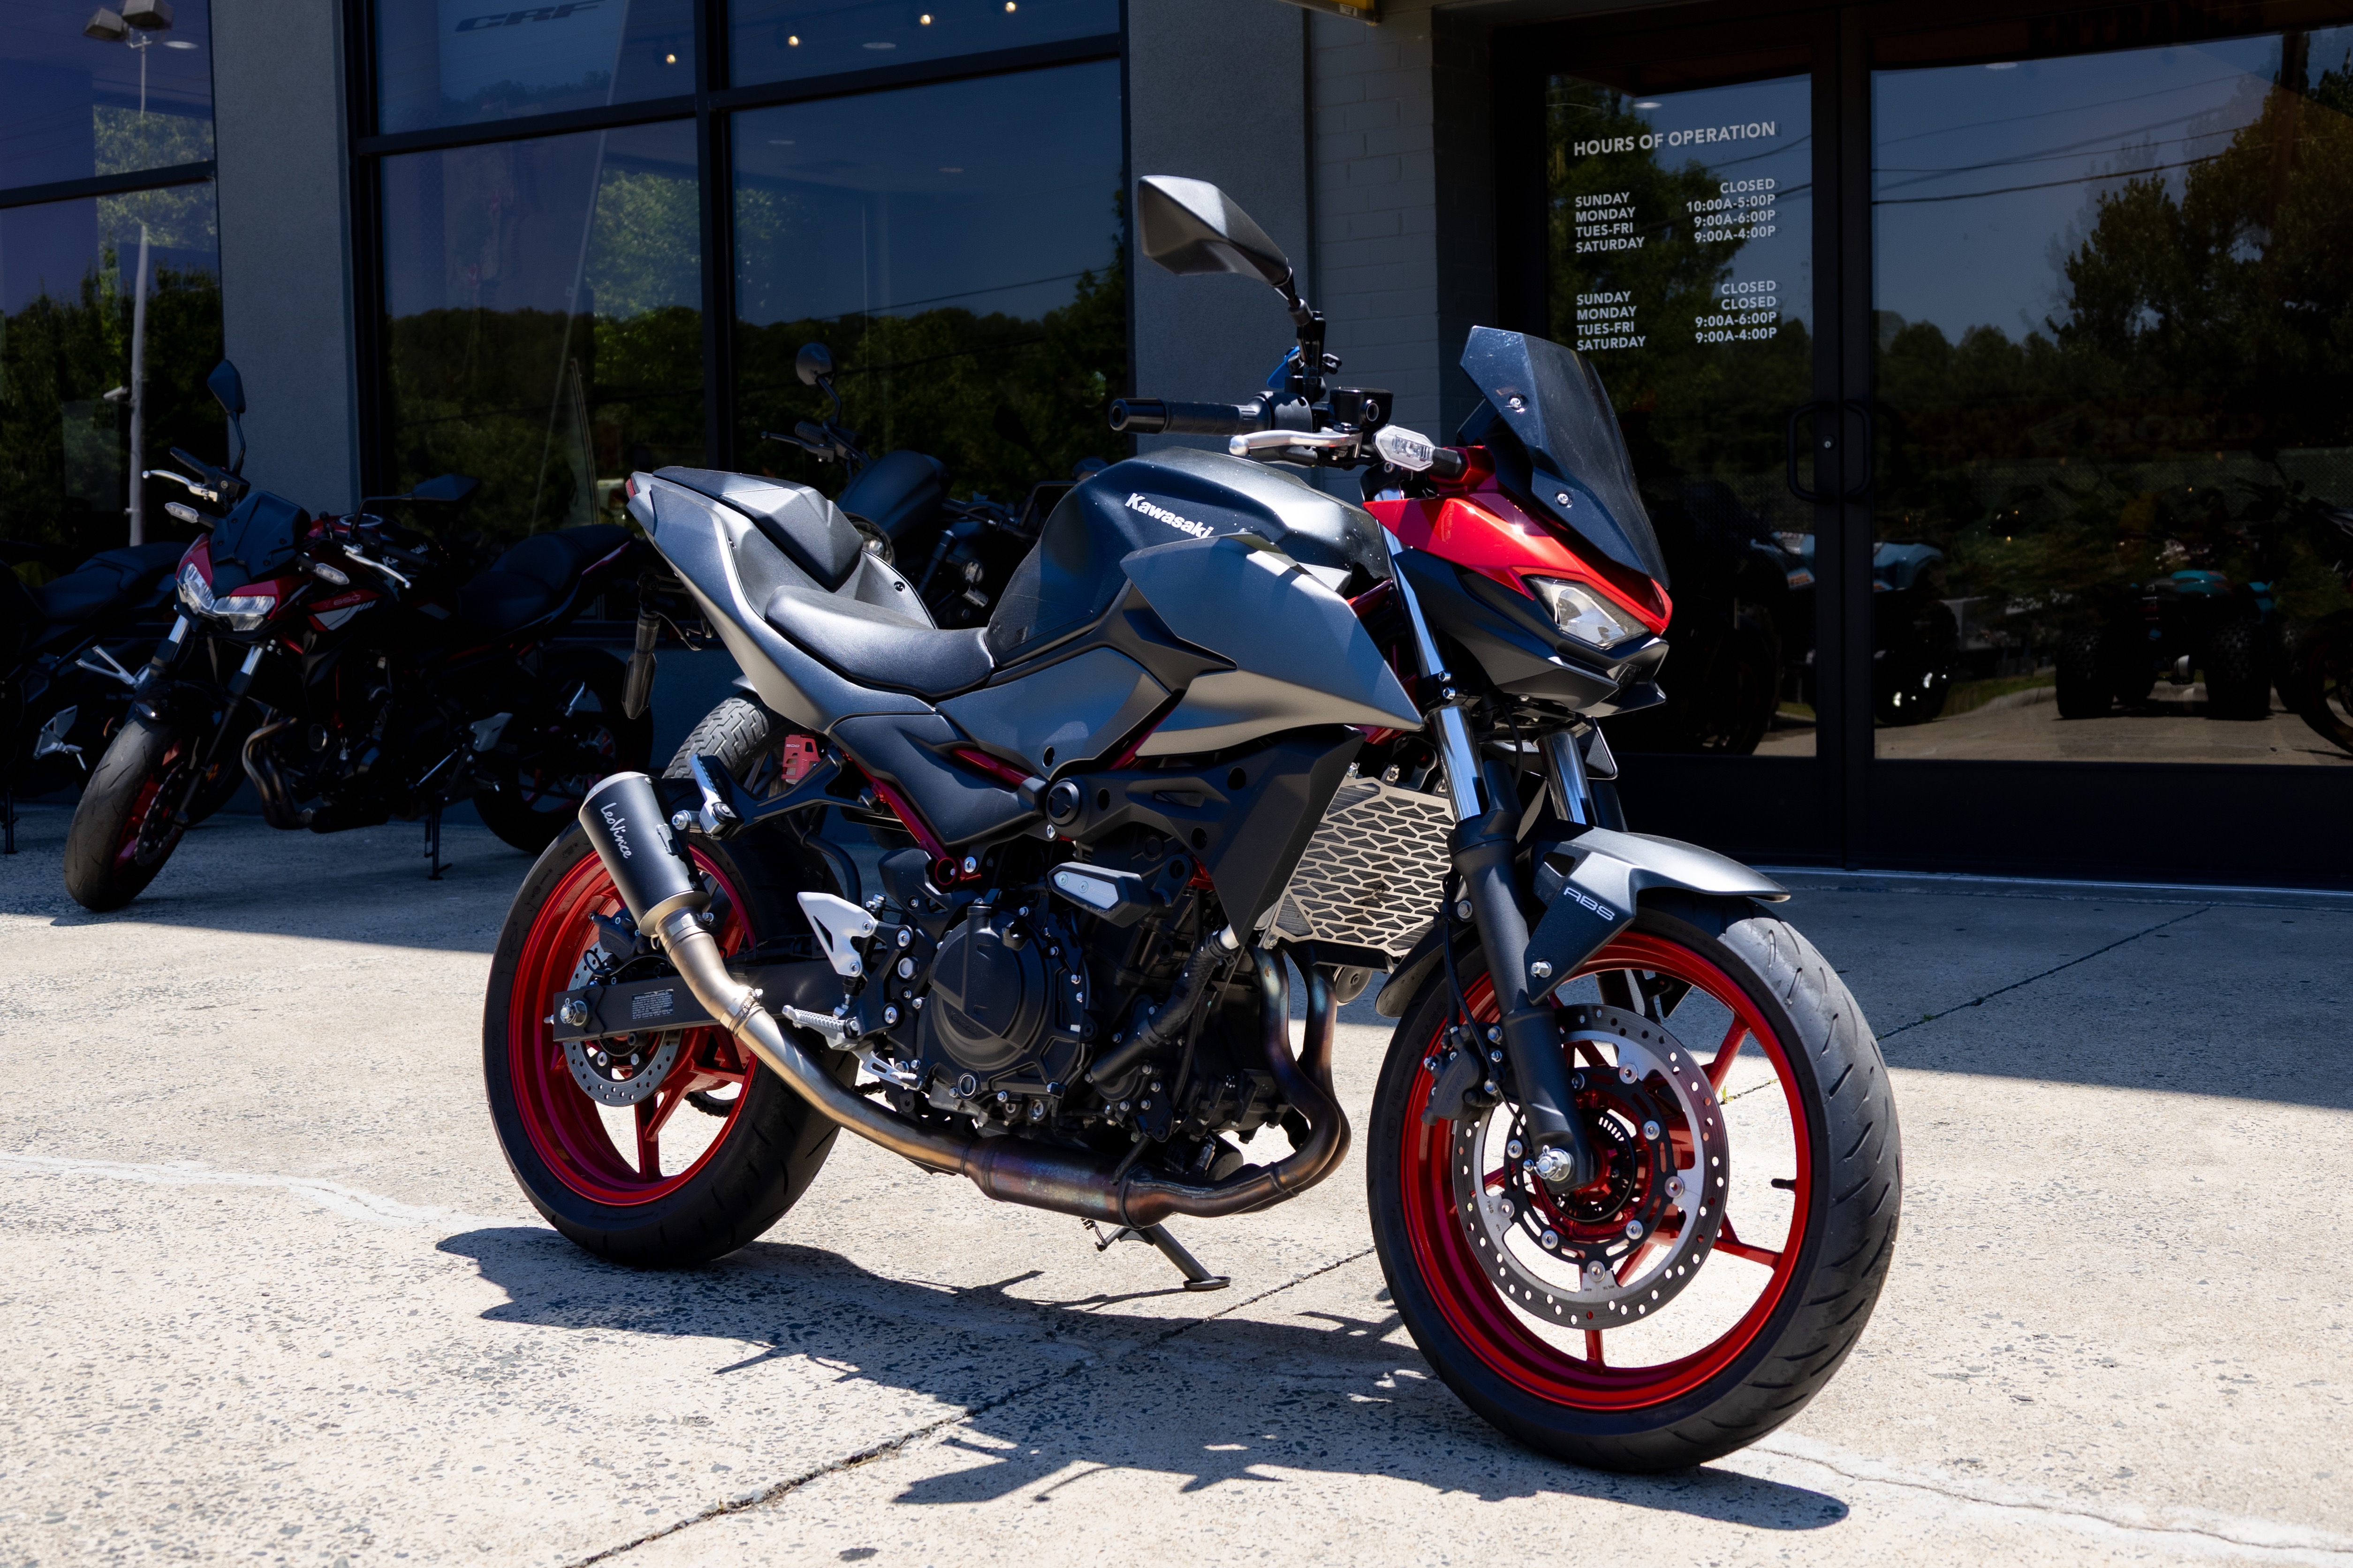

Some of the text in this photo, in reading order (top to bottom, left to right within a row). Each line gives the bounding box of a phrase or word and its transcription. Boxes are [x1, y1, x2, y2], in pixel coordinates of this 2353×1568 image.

[455, 0, 606, 32] CRF
[1574, 121, 1776, 156] HOURS OF OPERATION
[1720, 178, 1775, 194] CLOSED
[1575, 192, 1630, 207] SUNDAY
[1686, 194, 1776, 212] 10:00A-5:00P
[1576, 207, 1636, 222] MONDAY
[1694, 210, 1776, 227] 9:00A-6:00P
[1576, 222, 1633, 238] TUES-FRI
[1694, 226, 1776, 243] 9:00A-4:00P
[1576, 237, 1645, 253] SATURDAY
[1722, 281, 1776, 295] CLOSED
[1577, 291, 1631, 305] SUNDAY
[1722, 296, 1776, 311] CLOSED
[1577, 306, 1637, 320] MONDAY
[1695, 312, 1776, 327] 9:00A-6:00P
[1577, 322, 1634, 336] TUES-FRI
[1696, 327, 1777, 343] 9:00A-4:00P
[1577, 336, 1646, 351] SATURDAY
[1124, 492, 1214, 538] Kawasaki
[333, 594, 361, 606] 650
[600, 802, 632, 859] LeoVince
[1564, 887, 1615, 921] ABS
